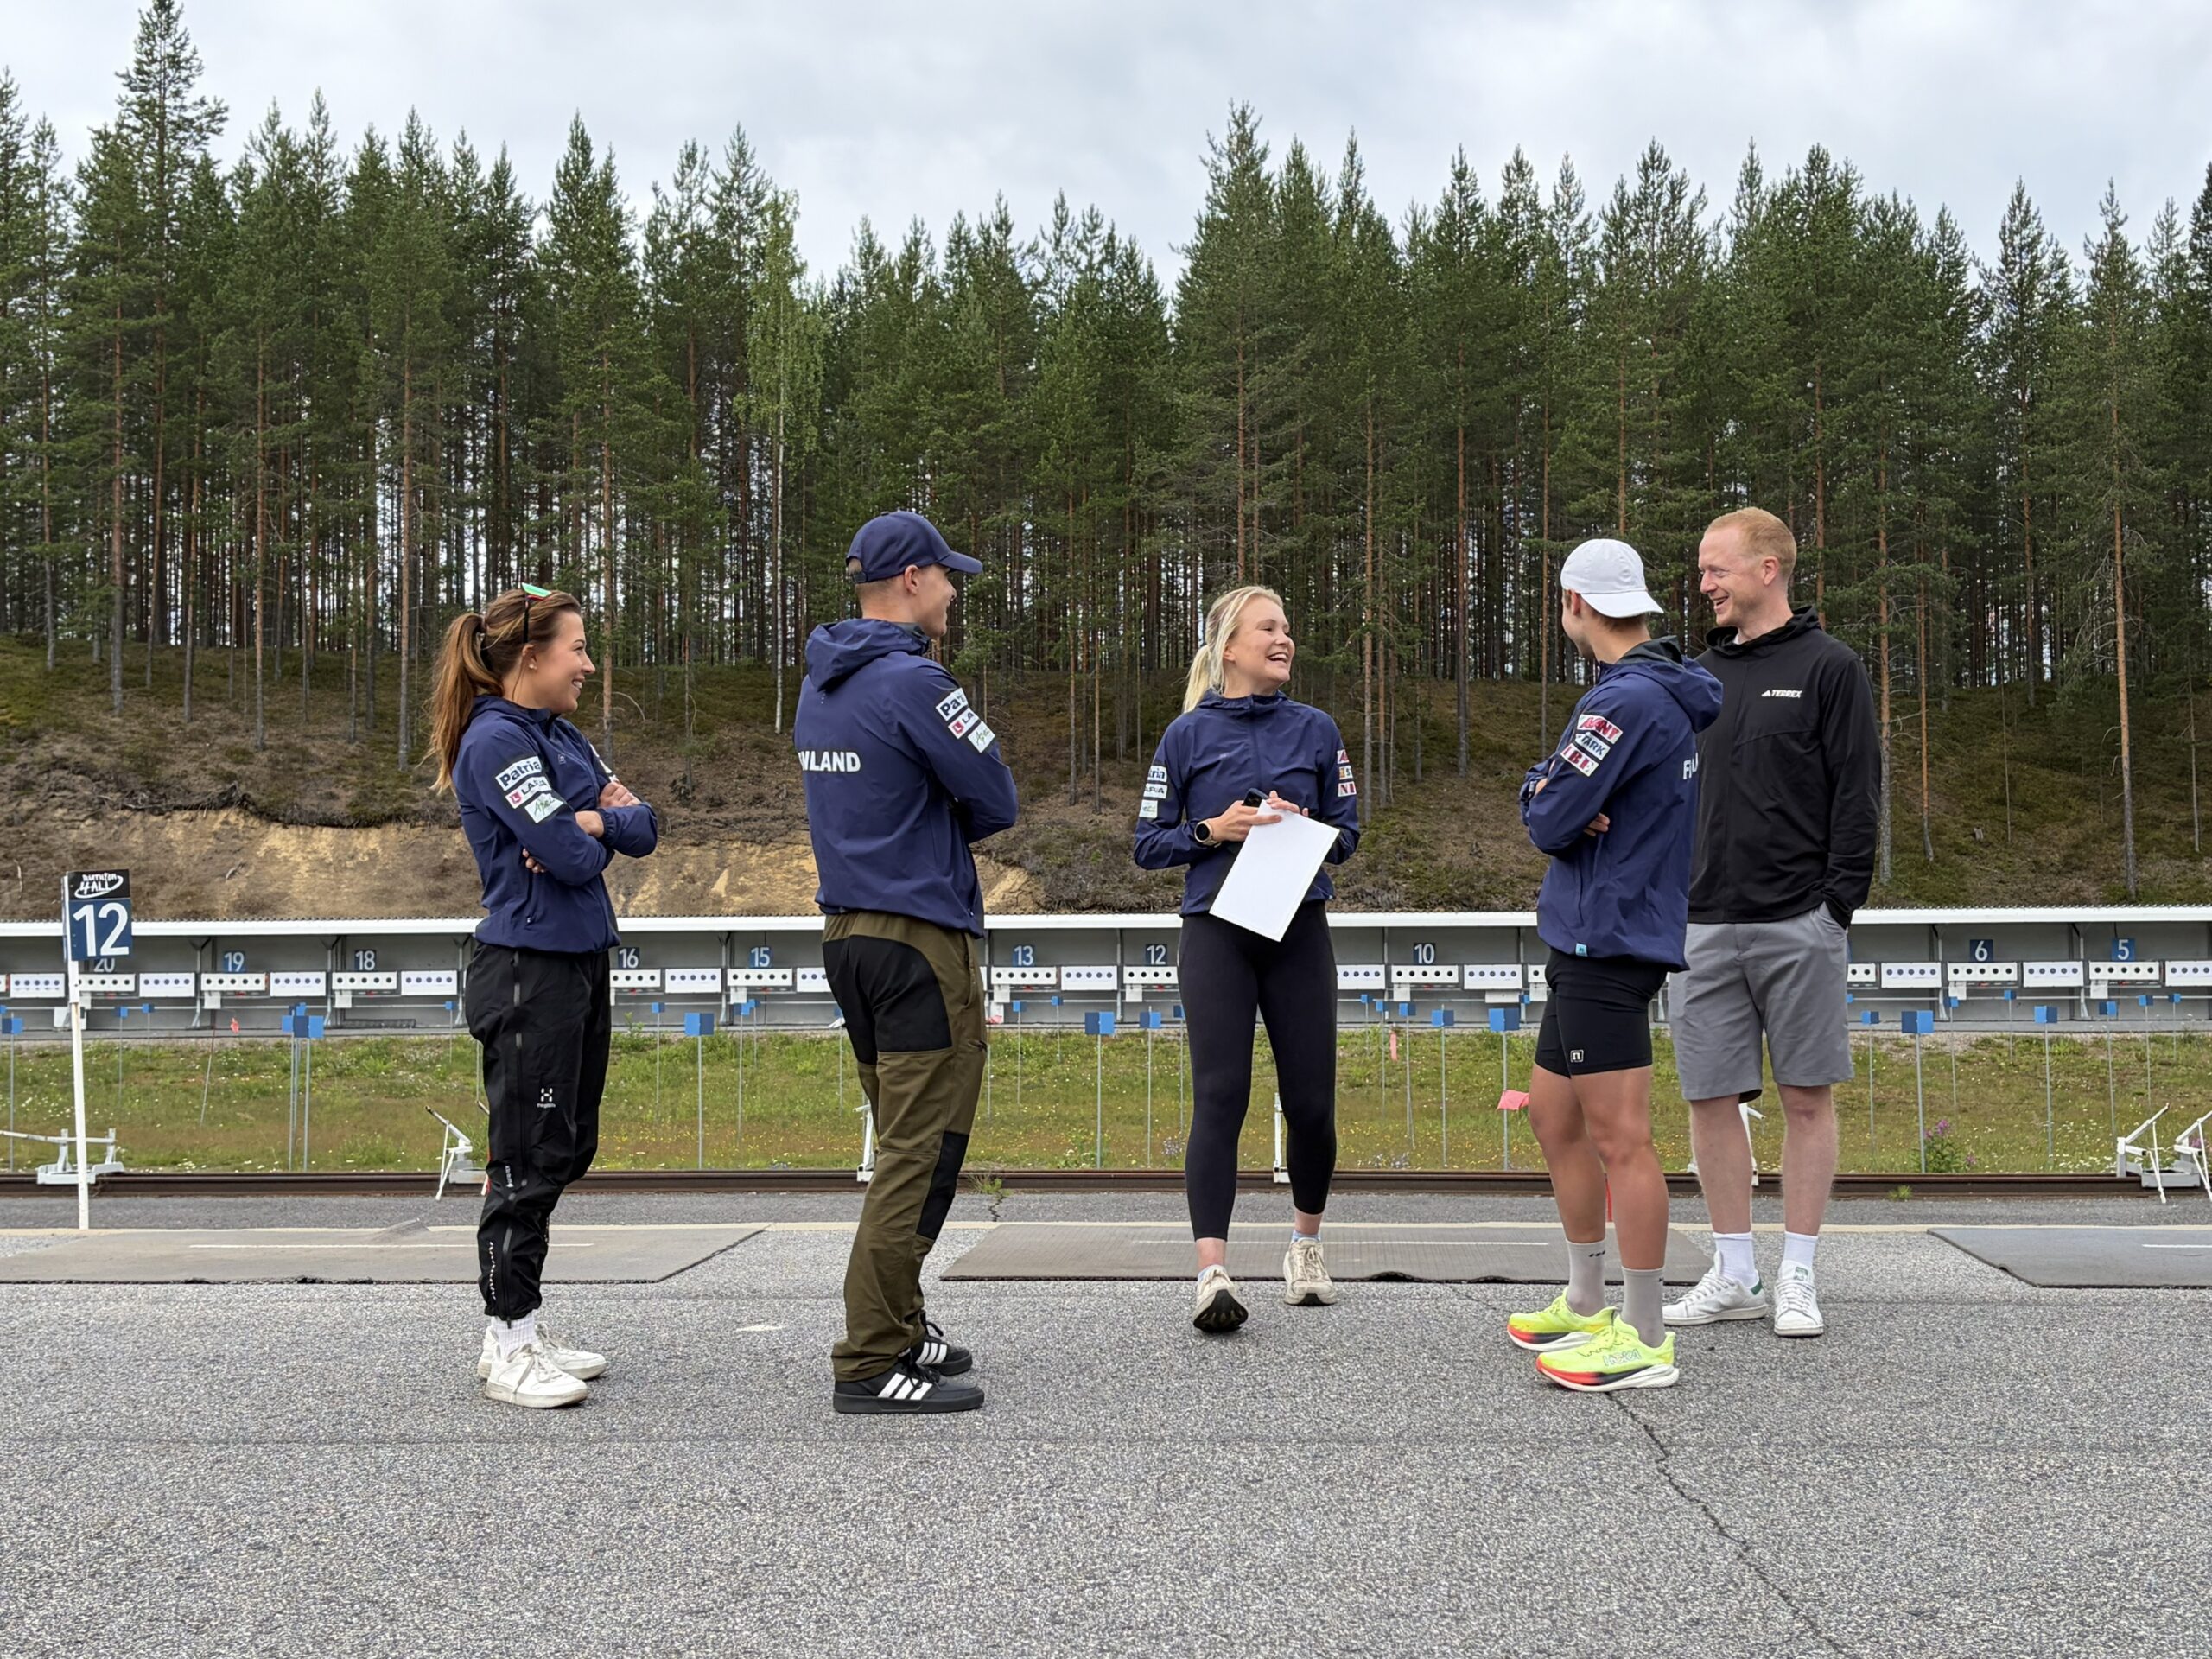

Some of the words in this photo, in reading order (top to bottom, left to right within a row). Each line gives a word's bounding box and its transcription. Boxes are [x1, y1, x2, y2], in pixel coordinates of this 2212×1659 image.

[1771, 690, 1802, 698] TERREX
[1579, 735, 1605, 756] TARK
[499, 761, 541, 787] Patria
[73, 903, 129, 957] 12
[619, 948, 639, 968] 16
[751, 947, 770, 967] 15
[1014, 946, 1034, 966] 13
[1147, 945, 1166, 964] 12
[1414, 944, 1434, 963] 10
[1975, 941, 1987, 961] 6
[2118, 939, 2129, 960] 5
[93, 958, 115, 972] 20
[225, 952, 244, 971] 19
[356, 950, 375, 970] 18
